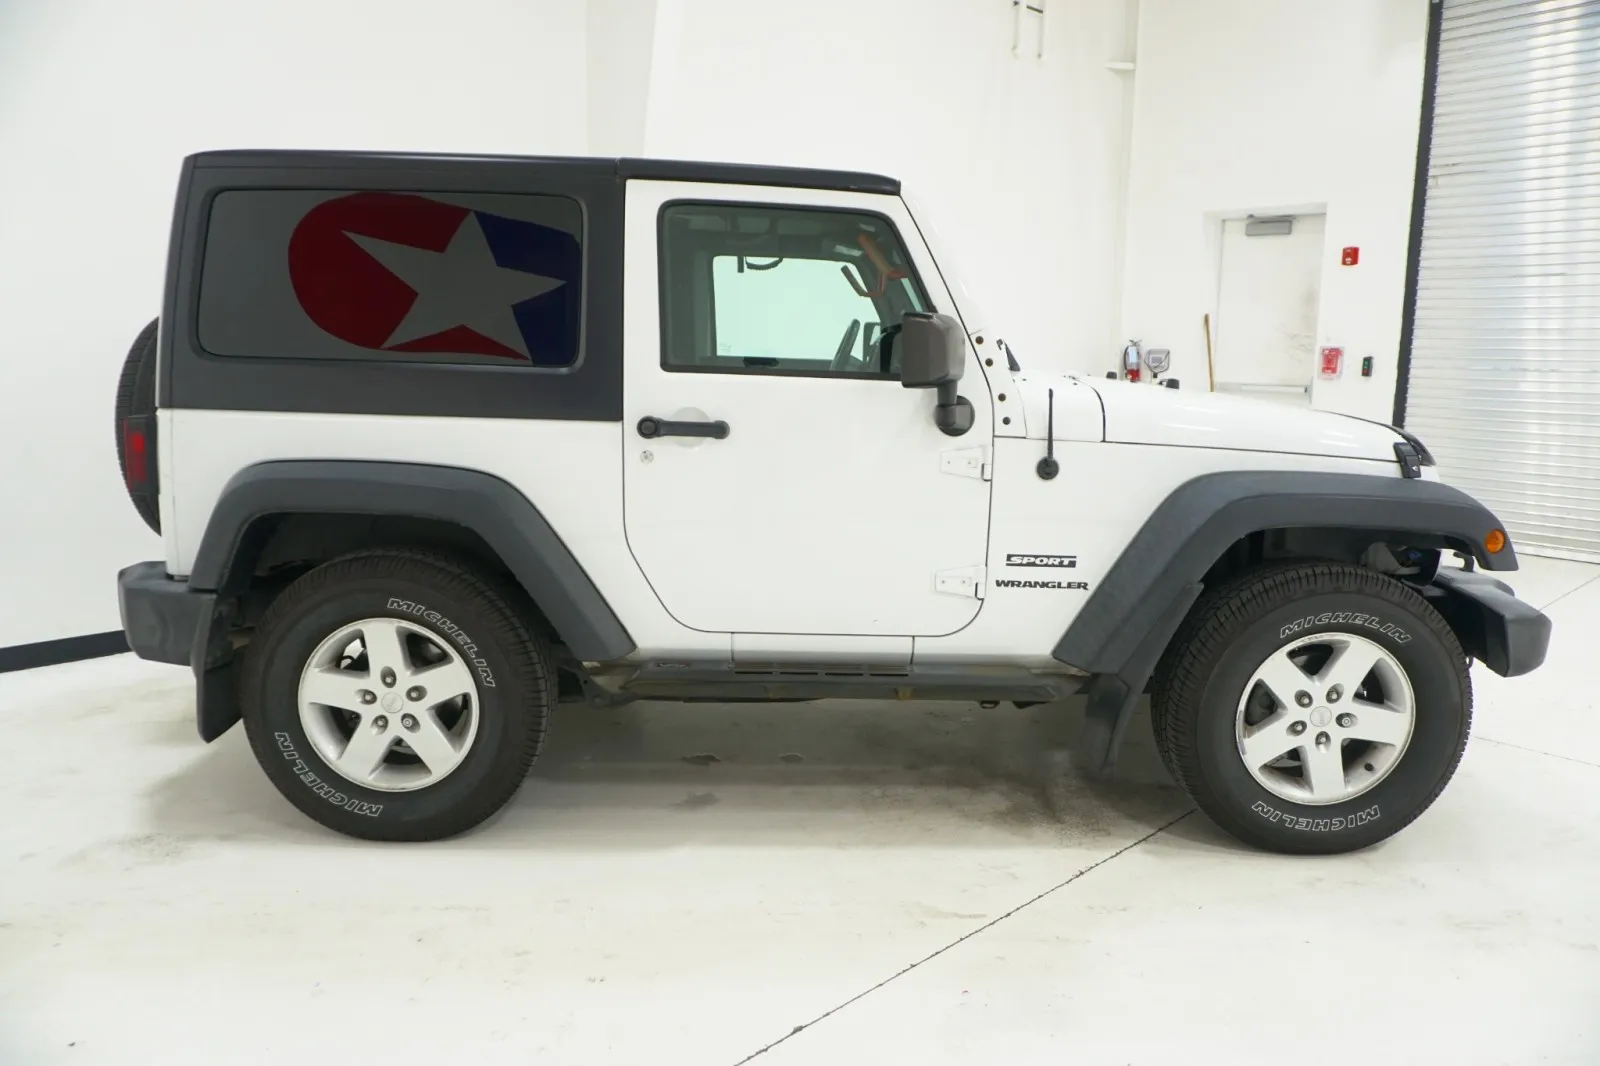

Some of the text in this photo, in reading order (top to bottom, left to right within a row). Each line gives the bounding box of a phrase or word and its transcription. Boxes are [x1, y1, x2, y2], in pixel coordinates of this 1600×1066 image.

[1008, 555, 1074, 566] SPORT
[995, 579, 1088, 590] WRANGLER
[387, 598, 495, 687] MICHELIN
[1280, 612, 1412, 643] MICHELIN
[275, 732, 383, 817] MICHELIN
[1252, 801, 1380, 831] MICHELIN
